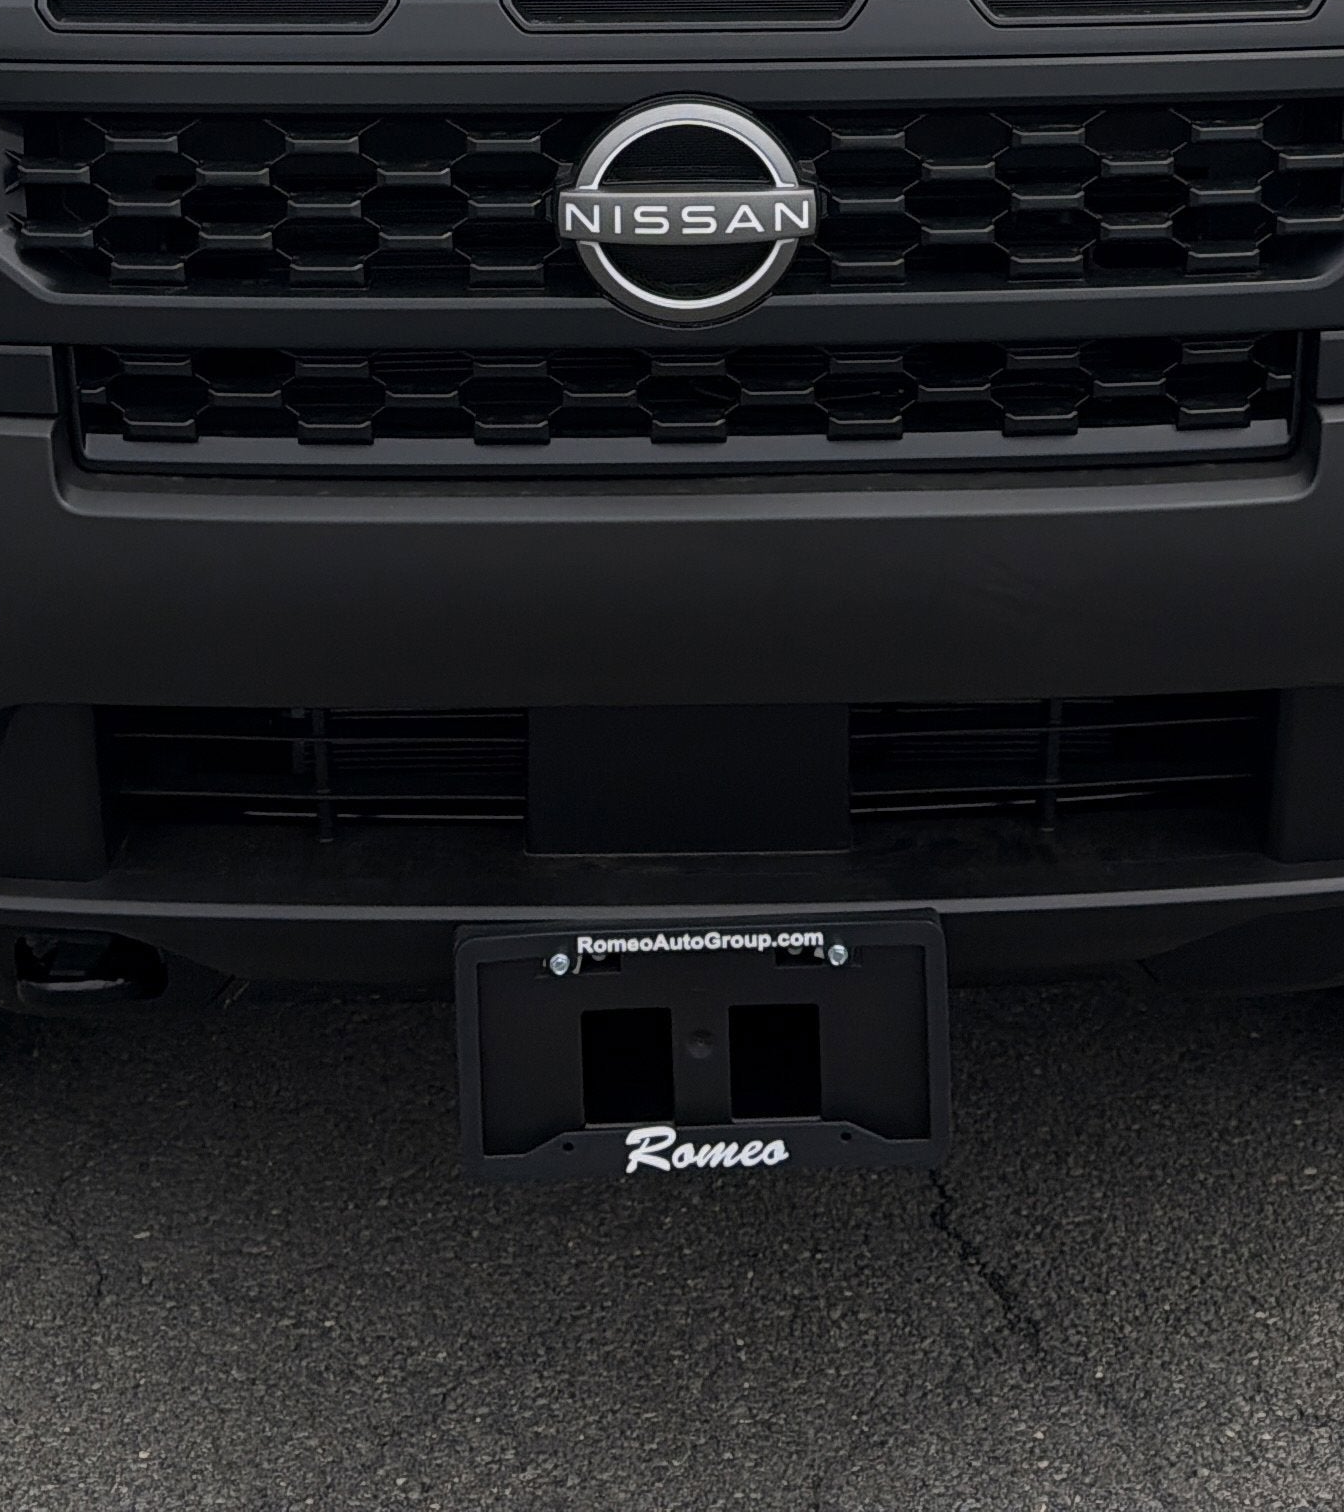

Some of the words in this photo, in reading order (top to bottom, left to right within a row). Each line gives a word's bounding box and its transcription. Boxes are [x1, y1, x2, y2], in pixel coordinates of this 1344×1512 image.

[564, 199, 810, 235] NISSAN
[576, 930, 824, 955] RomeoAutoGroup.com
[625, 1125, 789, 1174] Romeo
